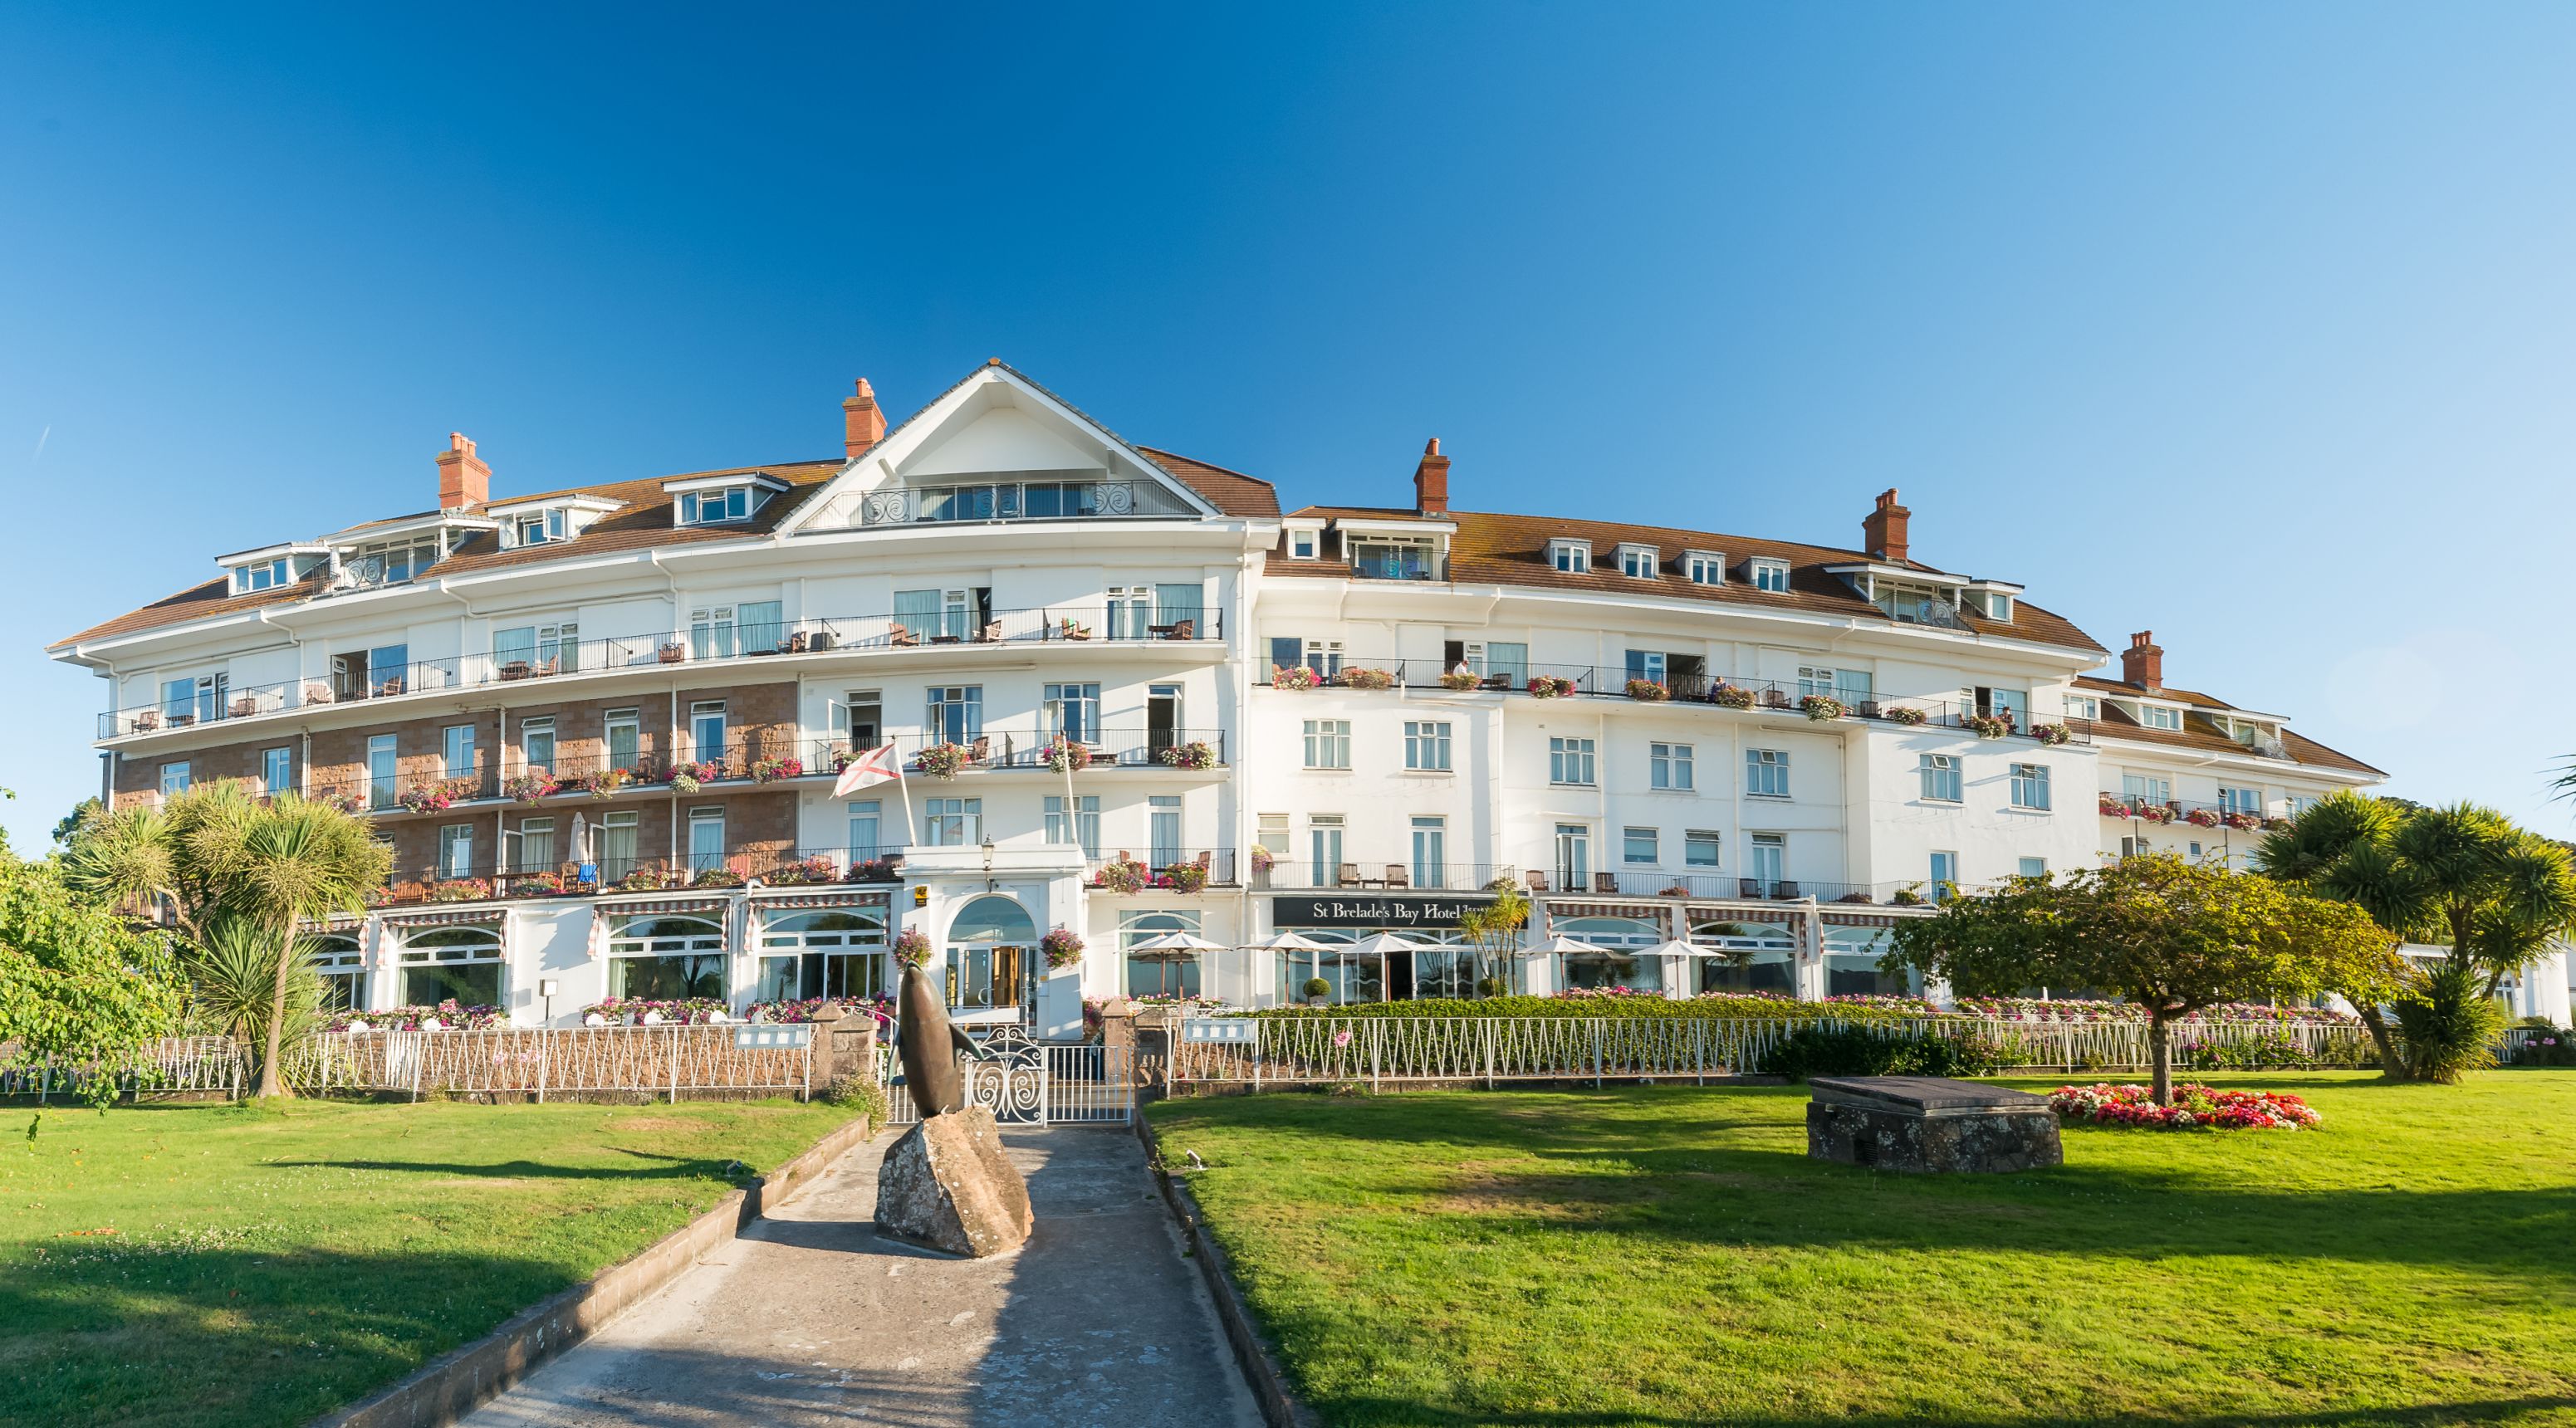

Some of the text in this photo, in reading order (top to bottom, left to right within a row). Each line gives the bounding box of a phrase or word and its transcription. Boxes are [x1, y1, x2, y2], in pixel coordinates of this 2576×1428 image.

[1313, 902, 1329, 918] St
[1330, 902, 1390, 918] Brelade's
[1393, 902, 1419, 925] Bay
[1423, 903, 1461, 919] Hotel
